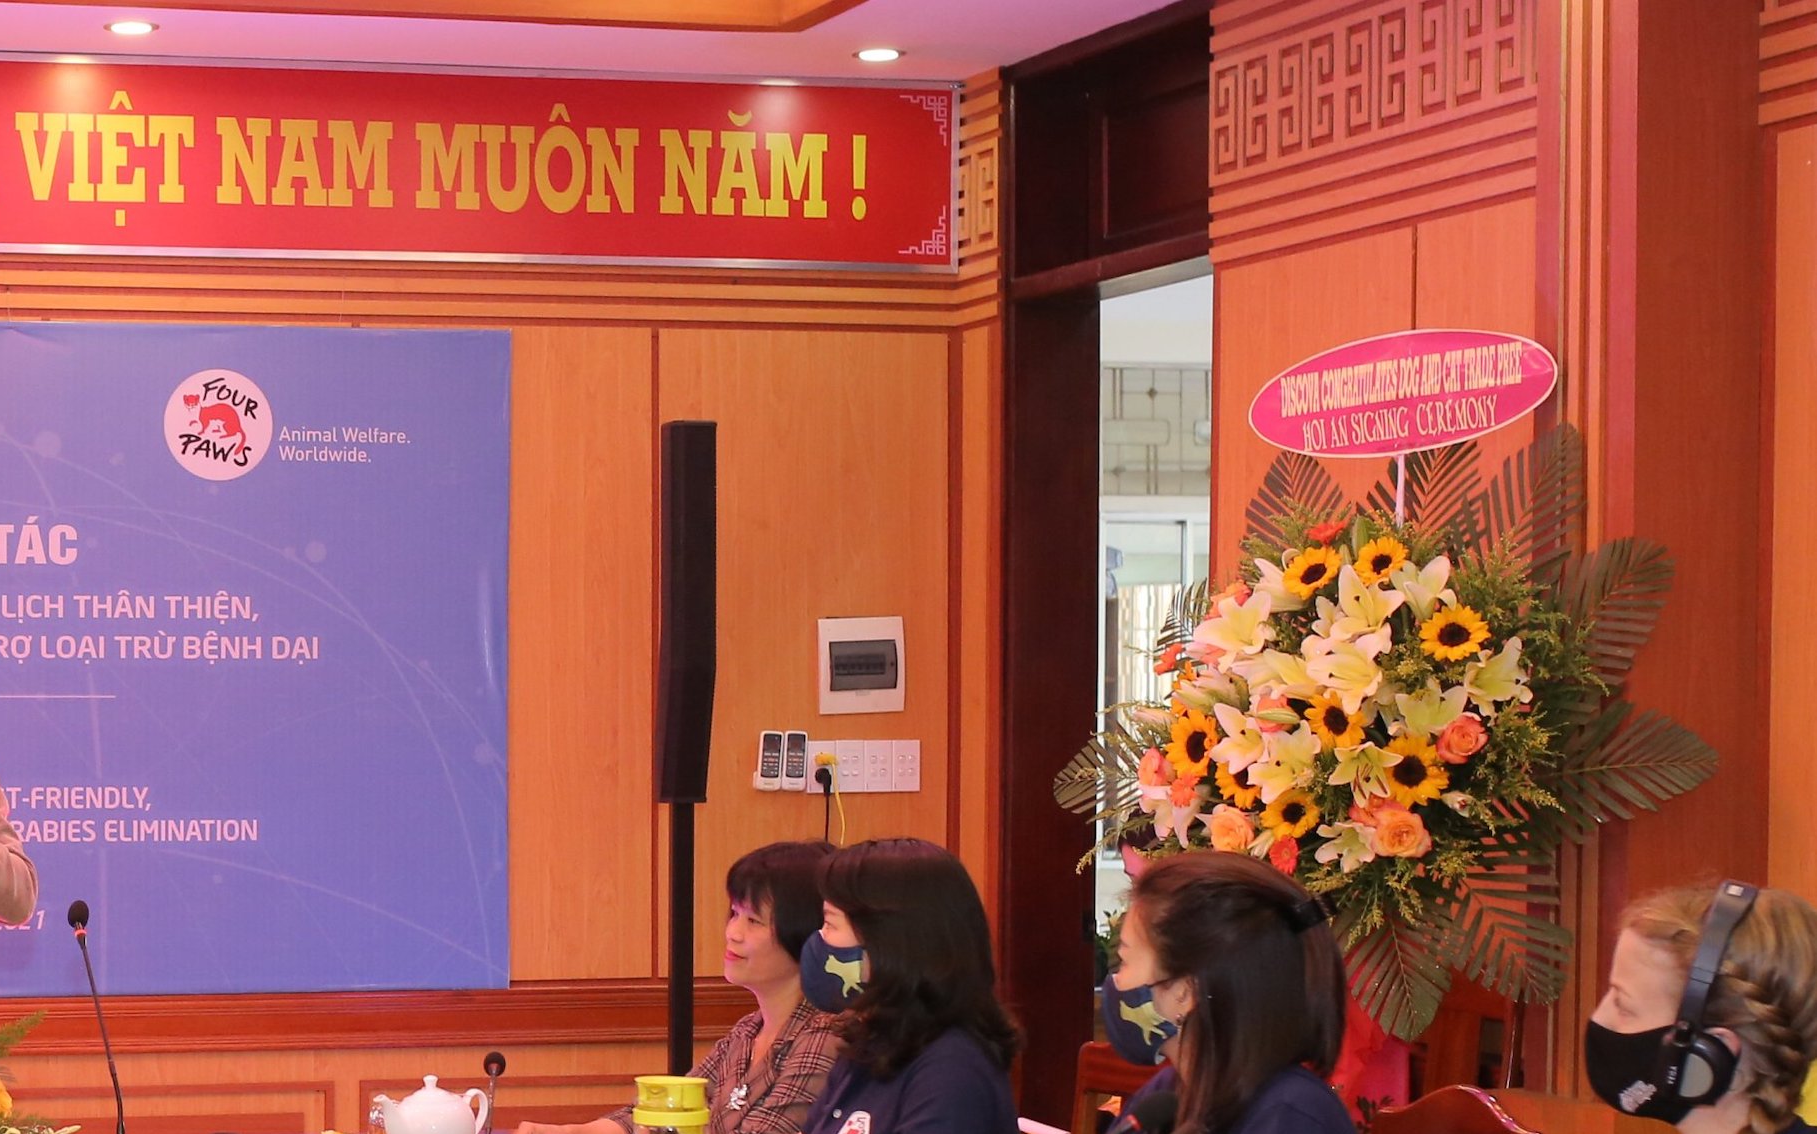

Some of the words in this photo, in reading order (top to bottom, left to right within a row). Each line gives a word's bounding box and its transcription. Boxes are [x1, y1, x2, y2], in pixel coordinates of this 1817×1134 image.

[14, 90, 194, 227] VIỆT
[216, 116, 393, 208] NAM
[415, 103, 640, 215] MUÔN
[659, 109, 828, 219] NĂM
[202, 377, 259, 420] FOUR
[1280, 371, 1321, 418] DISCOVA
[1321, 359, 1398, 412] CONGRATULATES
[1398, 355, 1420, 399] DOG
[1421, 352, 1442, 396] AND
[1443, 349, 1463, 394] CAT
[1464, 344, 1496, 391] TRADE
[279, 426, 338, 443] Animal
[341, 427, 412, 444] Welfare.
[1302, 418, 1327, 452] HOI
[1331, 415, 1349, 449] AN
[1350, 404, 1410, 445] SIGNING
[1415, 393, 1498, 437] CEREMONY
[178, 433, 253, 467] PAWS
[279, 445, 372, 463] Worldwide.
[1, 594, 64, 624] LỊCH
[73, 590, 155, 619] THÂN
[164, 590, 261, 626] THIỆN,
[40, 634, 106, 665] LOẠI
[114, 630, 177, 660] TRỪ
[183, 631, 263, 665] BỆNH
[272, 636, 319, 665] DẠI
[103, 819, 259, 843] ELIMINATION
